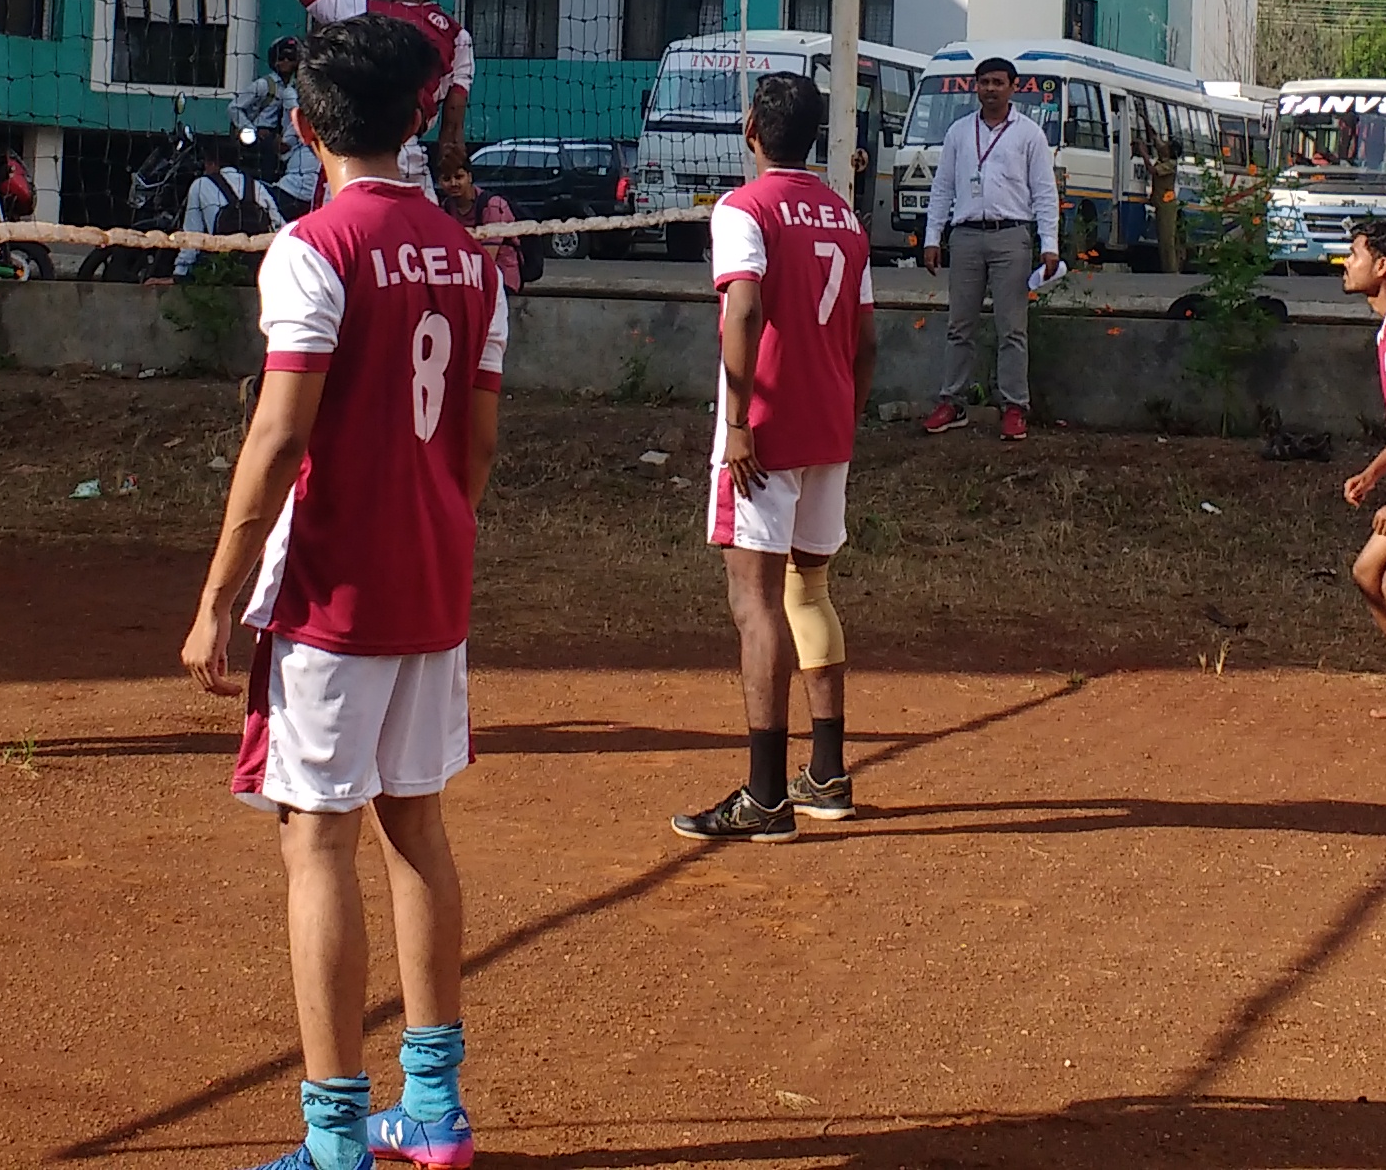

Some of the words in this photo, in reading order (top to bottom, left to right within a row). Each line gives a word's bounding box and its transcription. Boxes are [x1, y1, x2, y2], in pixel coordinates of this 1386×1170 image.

[691, 53, 771, 71] INDIRA
[813, 241, 846, 326] 7
[412, 309, 452, 444] 8
